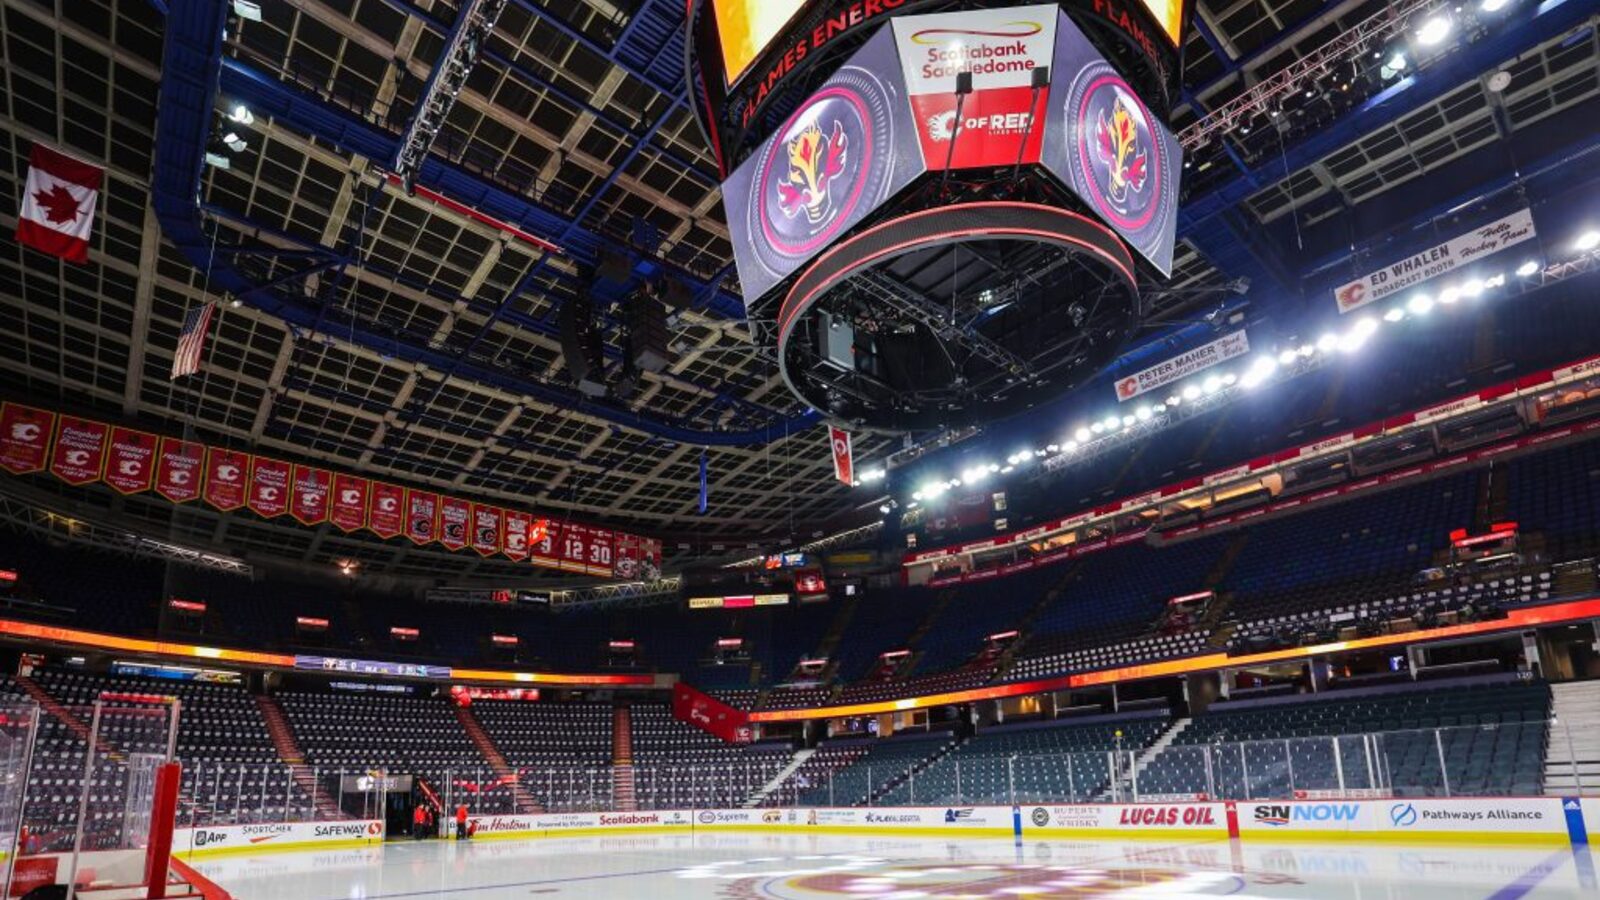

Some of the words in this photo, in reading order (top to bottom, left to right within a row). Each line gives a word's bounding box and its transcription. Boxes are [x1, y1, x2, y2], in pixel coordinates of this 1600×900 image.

[927, 41, 1026, 63] Scotiabank
[922, 59, 1035, 79] Saddledome
[742, 40, 808, 128] FLAMES
[965, 117, 988, 129] OF
[990, 112, 1035, 129] RED
[1459, 241, 1498, 258] Hockey
[1370, 271, 1388, 286] ED
[1391, 244, 1450, 276] WHALEN
[1371, 273, 1421, 298] BROADCAST
[1424, 260, 1455, 277] BOOTH
[1138, 362, 1173, 381] PETER
[1174, 346, 1216, 369] MAHER
[565, 540, 583, 560] 12
[590, 544, 610, 564] 30
[599, 810, 659, 826] Scotiabank
[717, 812, 749, 822] Supreme
[1119, 807, 1178, 826] LUCAS
[1183, 806, 1216, 825] OIL
[1254, 806, 1290, 819] SN
[1293, 804, 1360, 820] NOW
[1422, 809, 1484, 820] Pathways
[1486, 809, 1543, 819] Alliance
[315, 824, 366, 836] SAFEWAY
